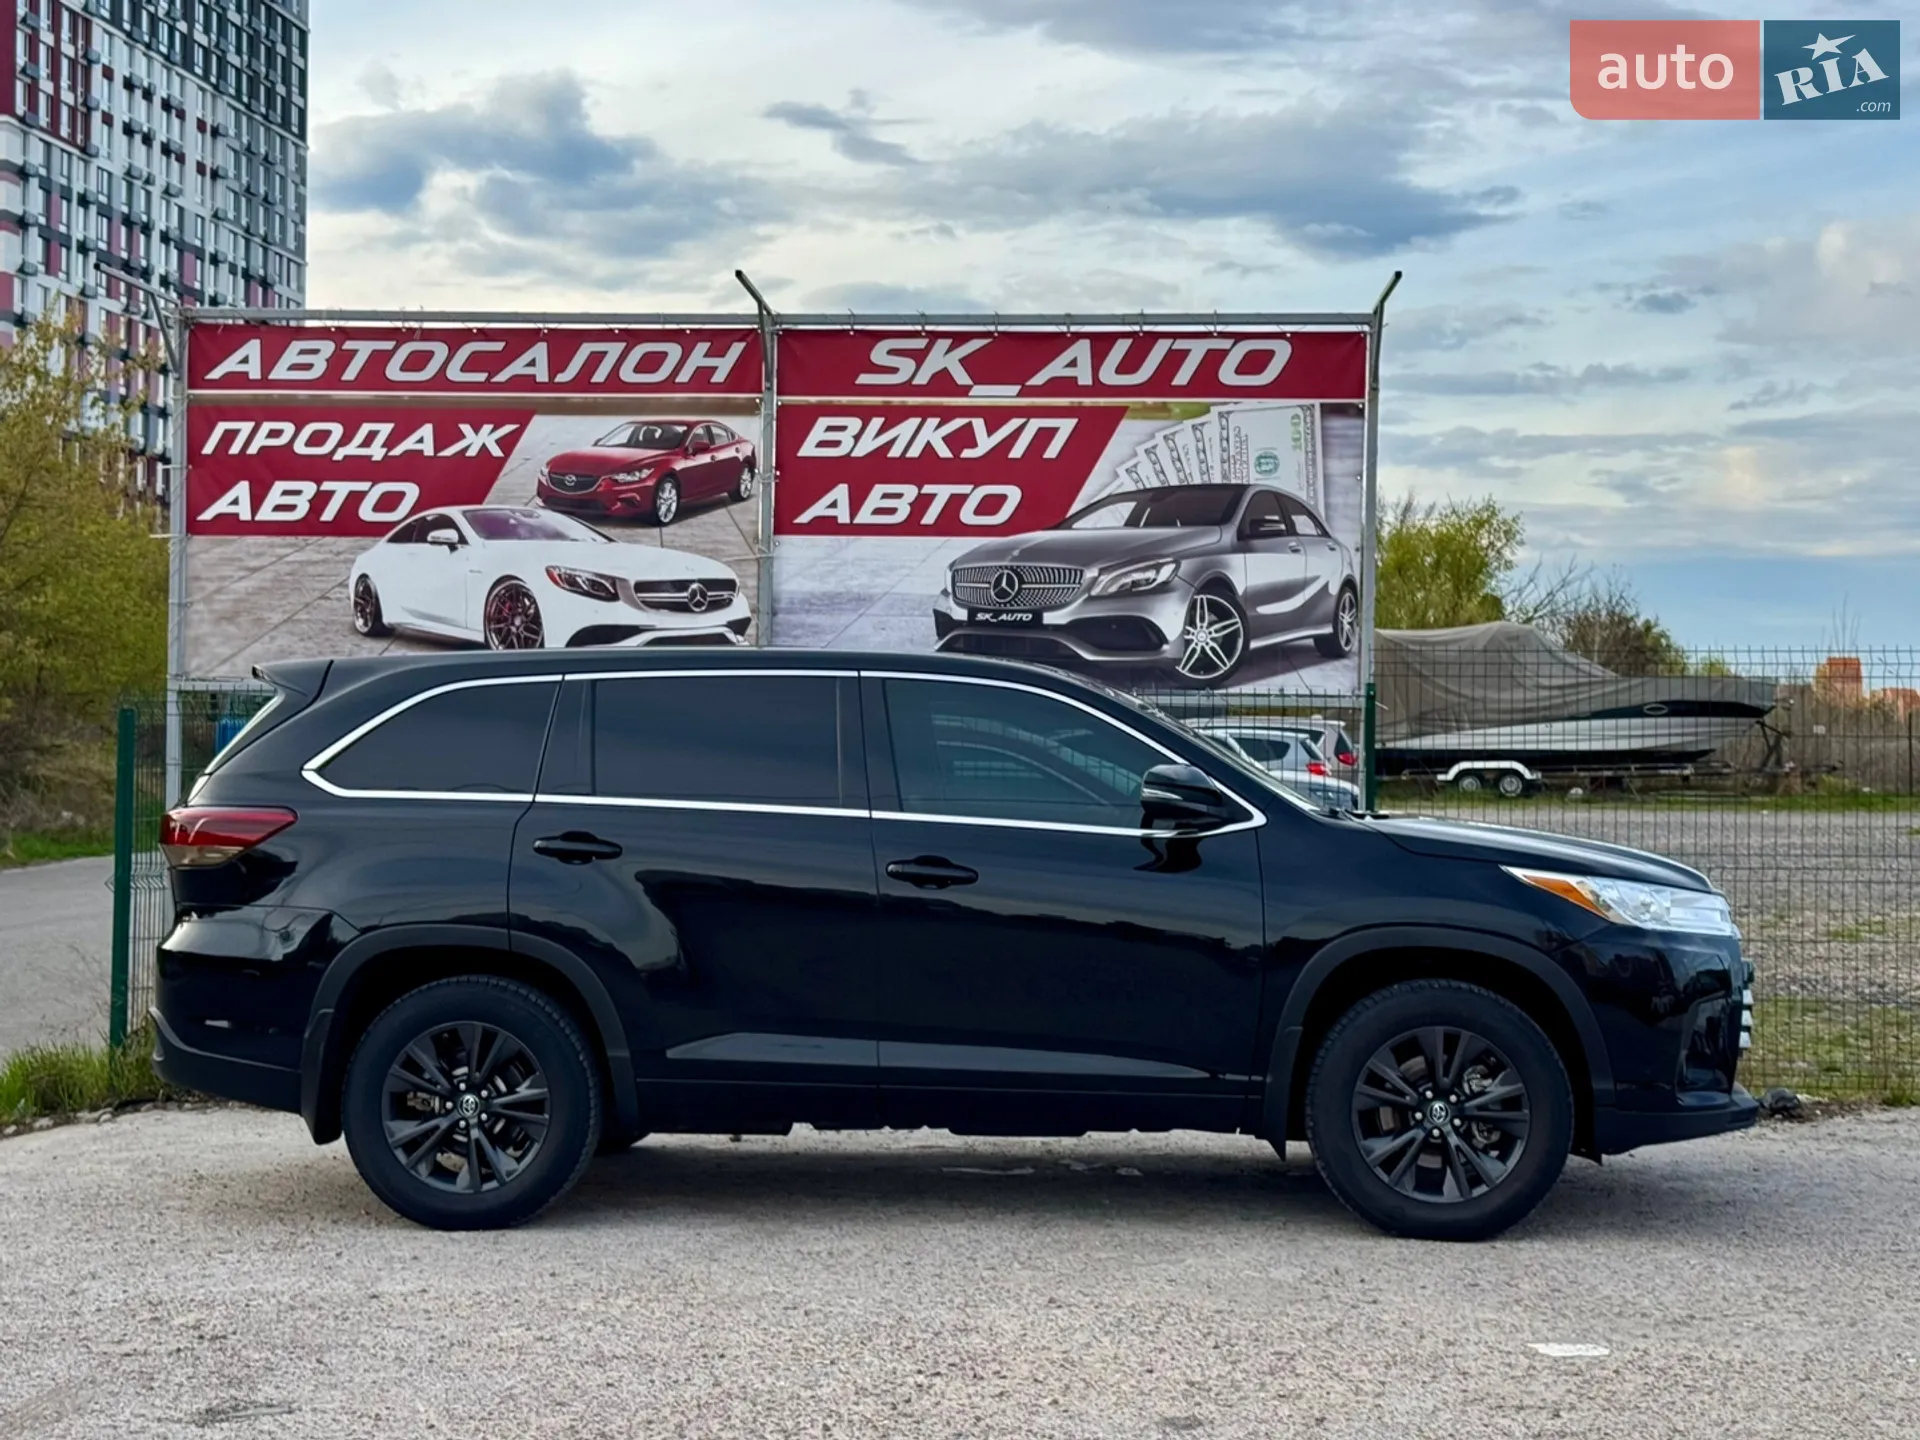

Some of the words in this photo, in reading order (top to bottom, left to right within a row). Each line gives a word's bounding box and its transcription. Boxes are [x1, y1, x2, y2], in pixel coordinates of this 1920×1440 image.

[203, 338, 748, 384] АВТОСАЛОН
[854, 337, 1293, 398] SK_AUTO
[200, 420, 521, 462] ПРОДАЖ
[796, 415, 1080, 460] ВИКУП
[196, 479, 421, 523] АВТО
[792, 482, 1024, 526] АВТО
[974, 611, 1034, 623] SK_AUTO
